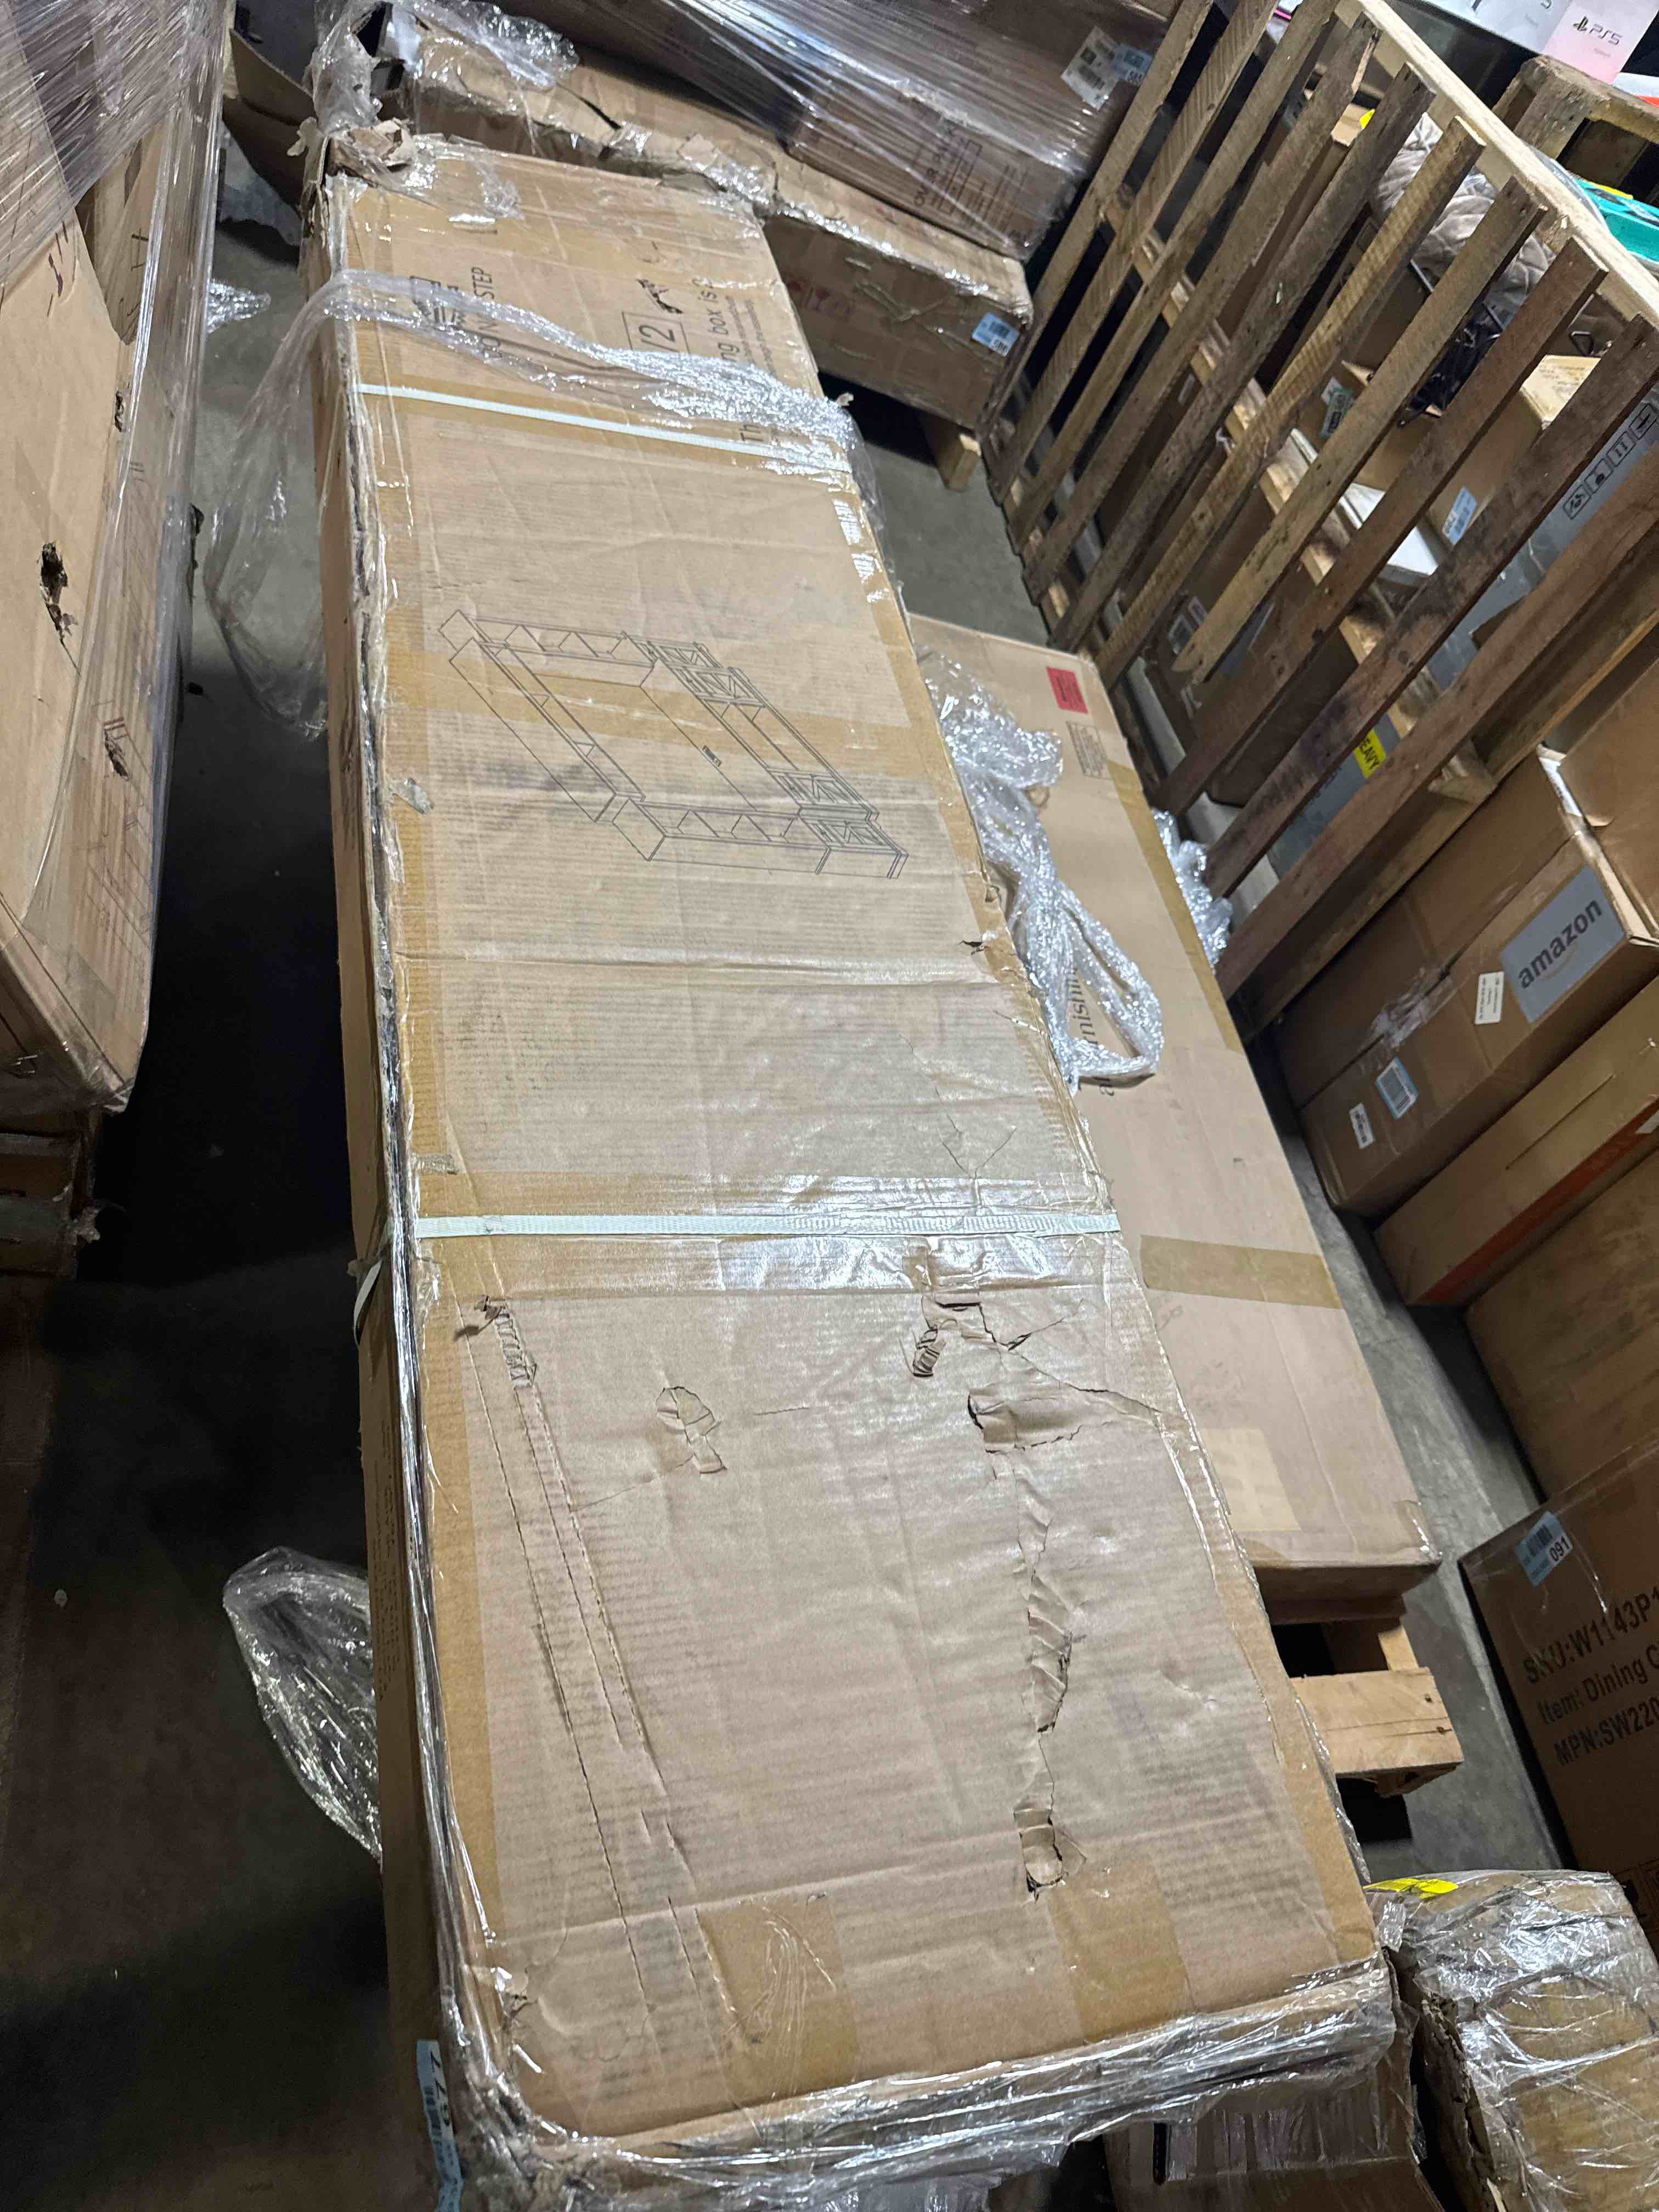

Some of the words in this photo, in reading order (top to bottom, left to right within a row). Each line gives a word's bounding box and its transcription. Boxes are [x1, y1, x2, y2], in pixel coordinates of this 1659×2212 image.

[1589, 24, 1622, 46] PS5
[471, 267, 495, 300] STEP
[707, 308, 729, 336] box
[1519, 900, 1602, 988] amazon
[1549, 1536, 1570, 1562] 091
[1538, 1688, 1584, 1725] Item:
[1582, 1658, 1648, 1702] Dining
